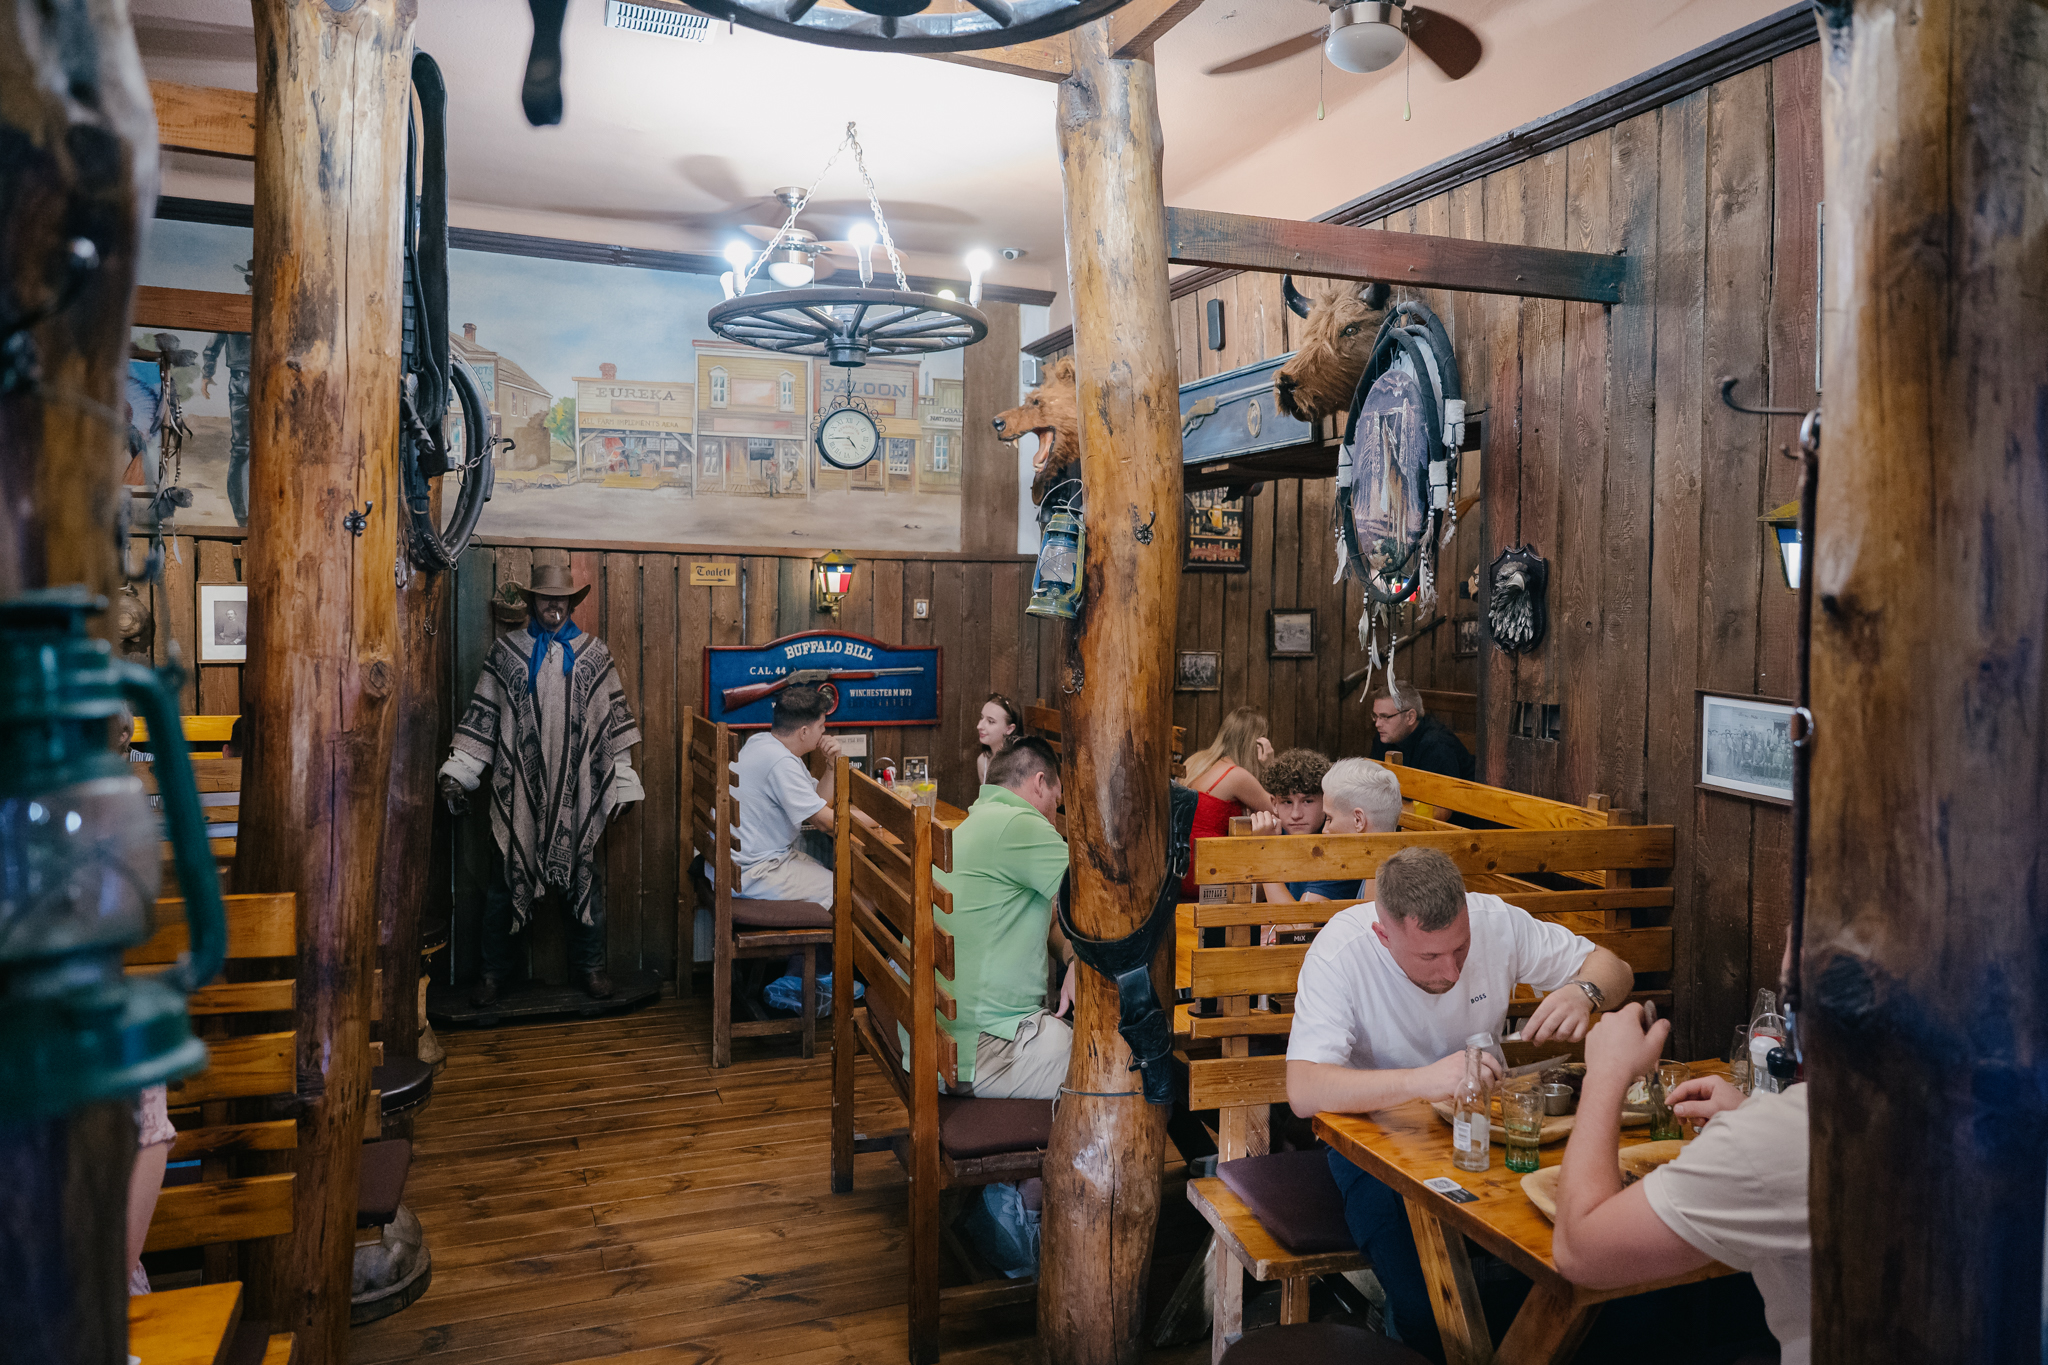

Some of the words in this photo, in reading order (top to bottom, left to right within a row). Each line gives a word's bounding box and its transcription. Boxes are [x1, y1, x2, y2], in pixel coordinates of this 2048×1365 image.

[595, 387, 676, 401] EUREKA
[823, 378, 907, 398] SALOON
[695, 565, 731, 577] Toalett
[784, 640, 843, 660] BUFFALO
[844, 642, 874, 661] BILL
[749, 666, 774, 675] CAL.
[775, 666, 787, 675] 44
[850, 688, 892, 697] WINCHESTER
[893, 688, 899, 697] M
[899, 688, 912, 697] 1873
[1470, 993, 1487, 1004] BOSS
